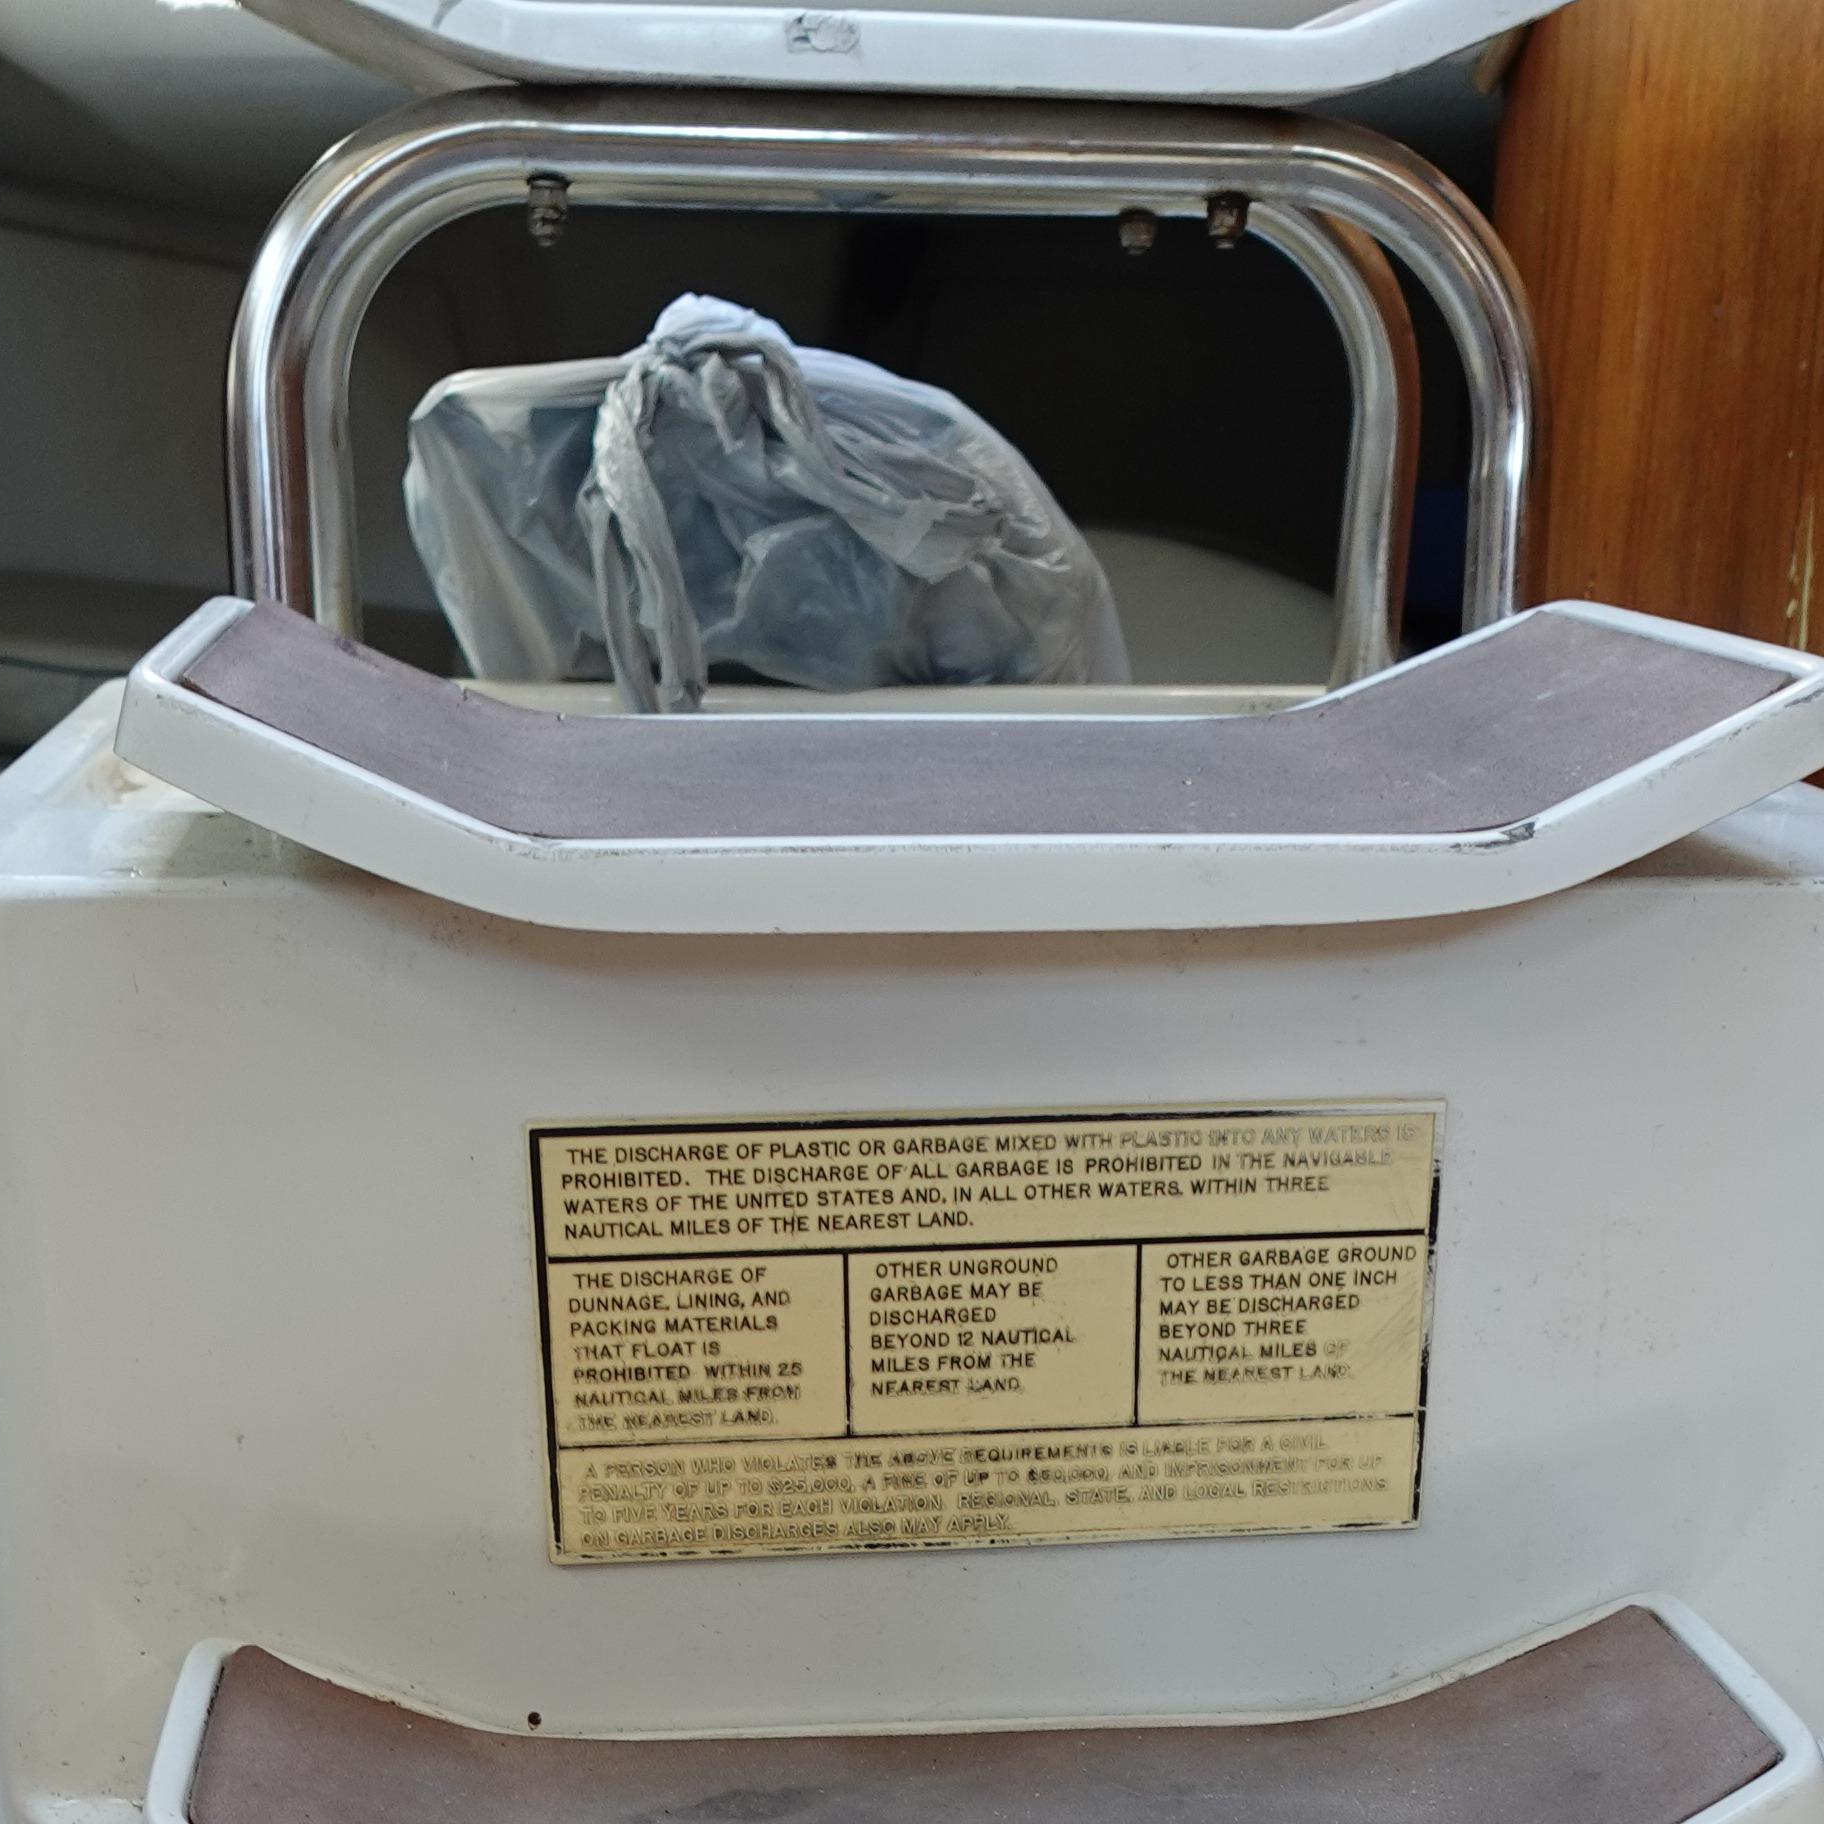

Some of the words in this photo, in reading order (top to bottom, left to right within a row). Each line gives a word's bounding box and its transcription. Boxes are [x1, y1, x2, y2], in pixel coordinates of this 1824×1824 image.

[566, 1148, 608, 1164] THE
[616, 1144, 728, 1163] DISCHARGE
[736, 1144, 763, 1160] OF
[770, 1141, 850, 1159] PLASTIC
[859, 1140, 885, 1156] OR
[893, 1136, 988, 1155] GARBAGE
[996, 1135, 1056, 1152] MIXED
[1065, 1134, 1111, 1148] WITH
[562, 1170, 690, 1189] PROHIBITED.
[706, 1169, 745, 1186] THE
[754, 1165, 868, 1184] DISCHARGE
[877, 1164, 902, 1180] OF
[910, 1163, 948, 1179] ALL
[956, 1160, 1048, 1178] GARBAGE
[1057, 1158, 1073, 1174] IS
[1086, 1155, 1201, 1174] PROHIBITED
[1213, 1154, 1230, 1170] IN
[1236, 1152, 1275, 1170] THE
[564, 1197, 648, 1216] WATERS
[656, 1196, 682, 1212] OF
[688, 1194, 728, 1210] THE
[736, 1191, 808, 1210] UNITED
[817, 1189, 894, 1206] STATES
[954, 1186, 971, 1204] IN
[980, 1186, 1017, 1202] ALL
[1024, 1183, 1090, 1200] OTHER
[1191, 1178, 1256, 1194] WITHIN
[1265, 1176, 1328, 1191] THREE
[565, 1222, 663, 1240] NAUTICAL
[671, 1219, 730, 1236] MILES
[738, 1218, 763, 1234] OF
[769, 1214, 808, 1235] THE
[818, 1213, 910, 1232] NEAREST
[918, 1211, 973, 1228] LAND.
[876, 1261, 942, 1278] OTHER
[949, 1258, 1057, 1276] UNGROUND
[1167, 1252, 1231, 1269] OTHER
[1239, 1248, 1329, 1266] GARBAGE
[1338, 1246, 1416, 1263] GROUND
[573, 1273, 614, 1289] THE
[621, 1269, 733, 1288] DISCHARGE
[741, 1267, 766, 1283] OF
[1160, 1277, 1185, 1292] TO
[1193, 1275, 1243, 1292] LESS
[1249, 1272, 1300, 1290] THAN
[1309, 1272, 1346, 1288] ONE
[1354, 1270, 1396, 1286] INCH
[677, 1292, 744, 1310] LINING,
[752, 1290, 790, 1306] AND
[870, 1284, 962, 1302] GARBAGE
[970, 1283, 1010, 1299] MAY
[1019, 1282, 1042, 1298] BE
[1160, 1300, 1199, 1316] MAY
[1207, 1299, 1231, 1315] BE
[1239, 1294, 1360, 1313] DISCHARGED
[870, 1307, 996, 1326] DISCHARGED
[871, 1332, 950, 1350] BEYOND
[958, 1331, 973, 1346] 12
[982, 1328, 1073, 1346] NAUTICAL
[1160, 1322, 1235, 1339] BEYOND
[1244, 1320, 1306, 1336] THREE
